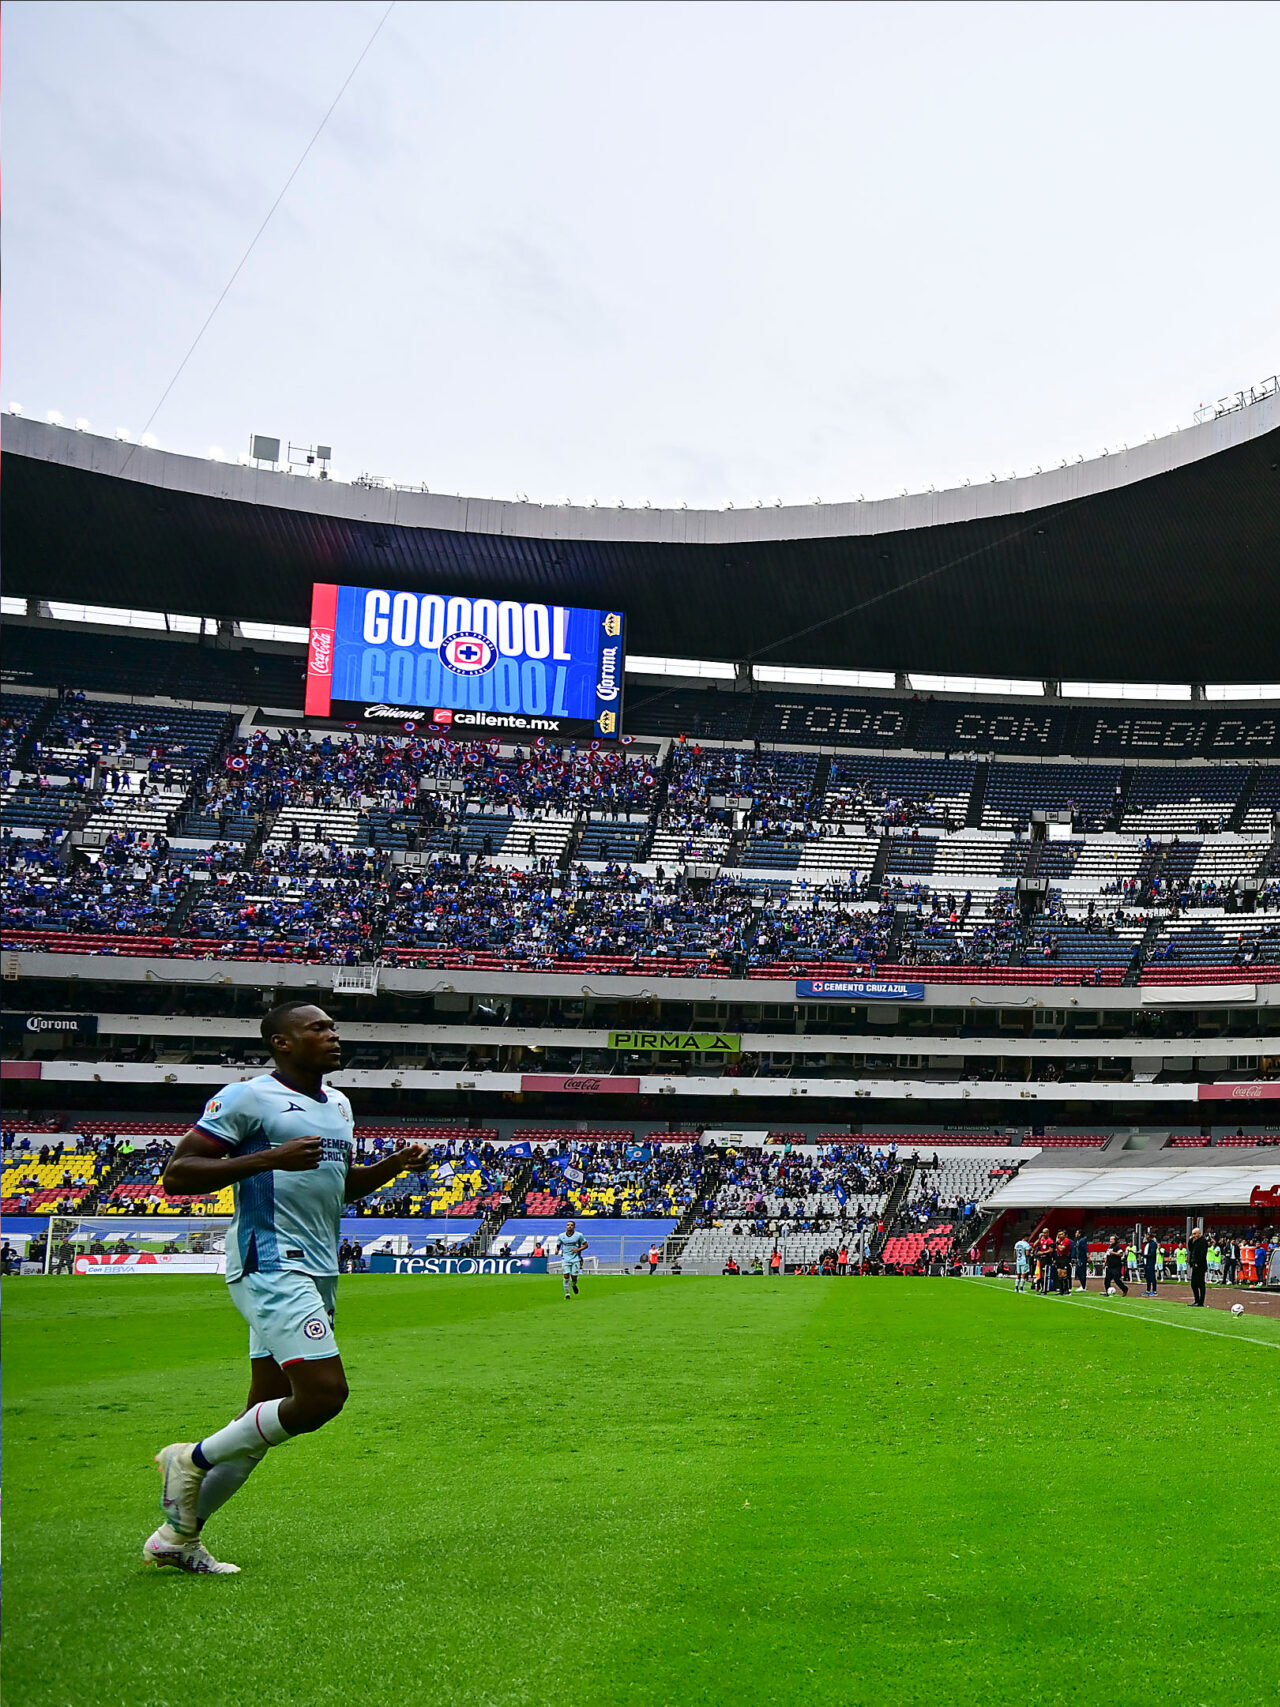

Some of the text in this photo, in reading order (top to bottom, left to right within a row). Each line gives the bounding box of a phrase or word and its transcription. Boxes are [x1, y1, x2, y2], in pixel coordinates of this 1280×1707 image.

[596, 646, 621, 701] Corona
[454, 712, 560, 731] caliente.mx
[774, 704, 1277, 747] TODO CON MEDIDA
[824, 983, 908, 993] CEMENTO CRUZ AZUL
[26, 1016, 79, 1033] Corona
[614, 1033, 701, 1050] PIRMA
